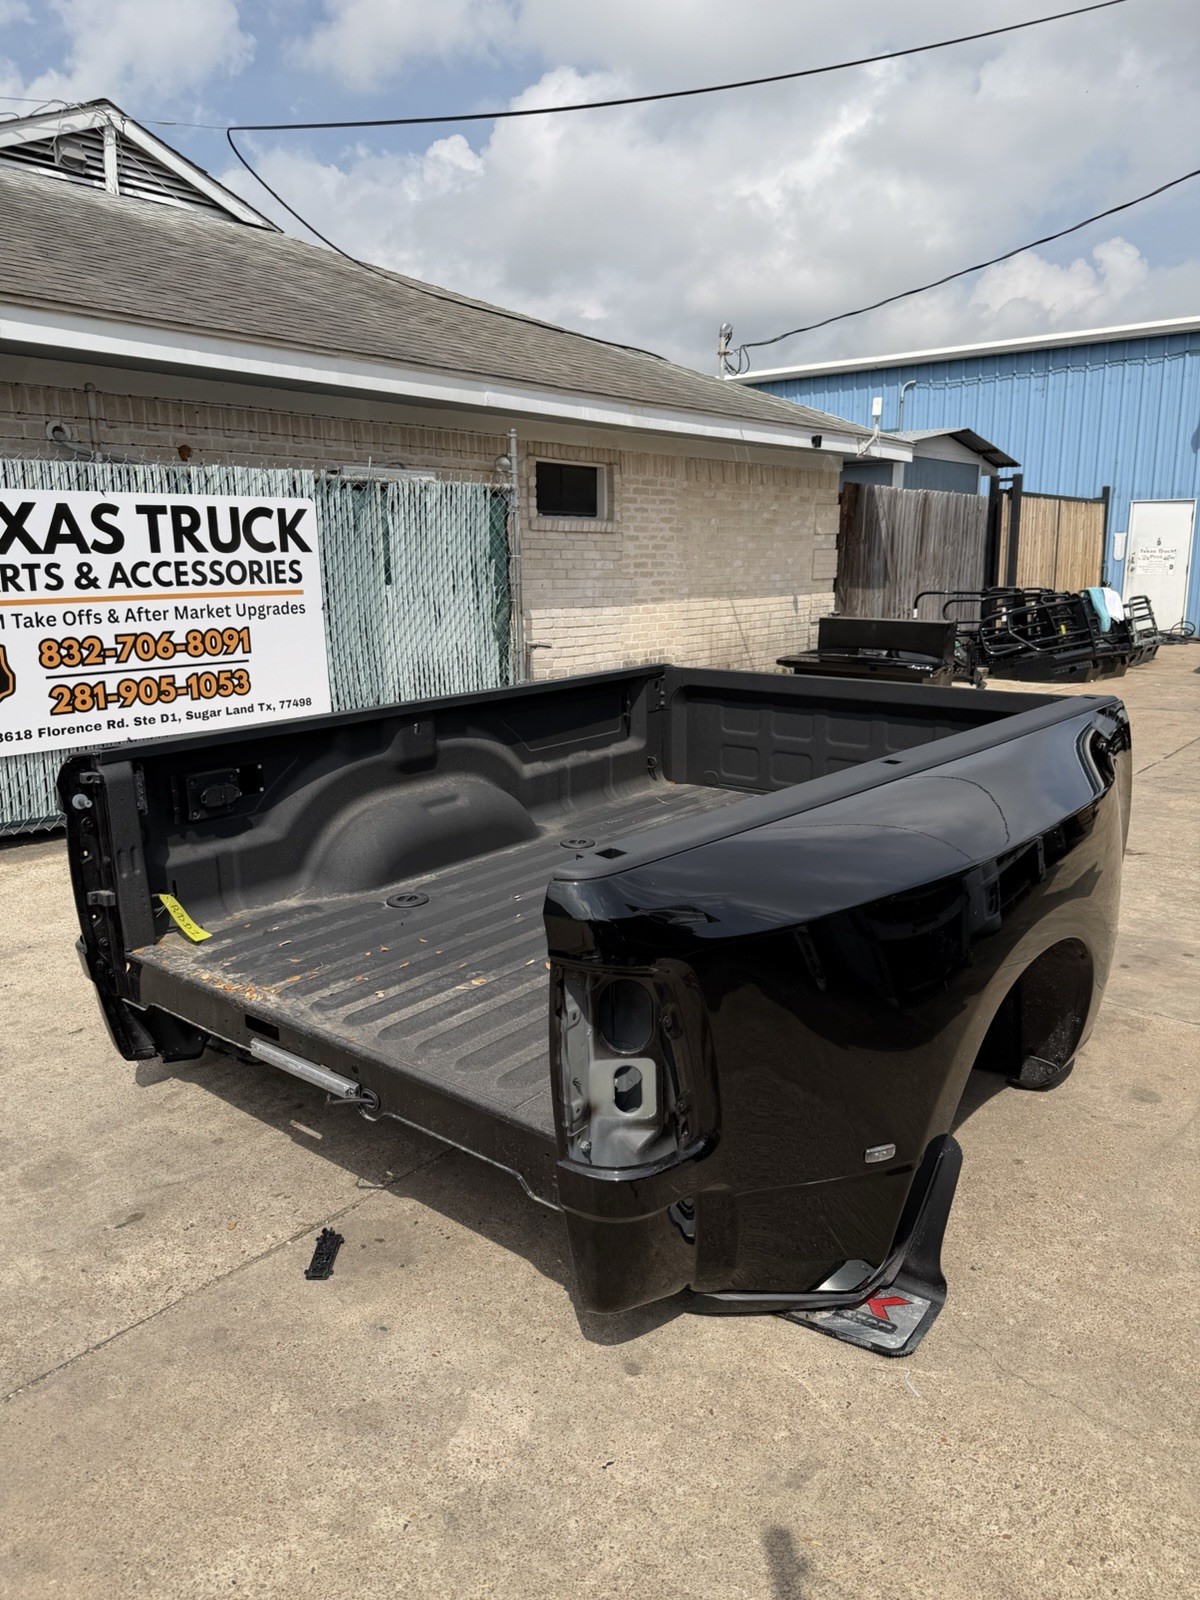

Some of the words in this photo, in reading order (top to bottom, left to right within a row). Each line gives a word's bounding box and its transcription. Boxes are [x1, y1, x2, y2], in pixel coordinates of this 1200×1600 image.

[0, 501, 125, 556] XAS
[134, 504, 313, 554] TRUCK
[0, 562, 65, 592] RTS
[74, 561, 101, 591] &
[107, 559, 303, 589] ACCESSORIES
[11, 611, 57, 629] Take
[62, 608, 103, 627] Offs
[107, 608, 120, 624] &
[124, 605, 170, 623] After
[173, 603, 232, 621] Market
[235, 600, 306, 621] Upgrades
[38, 626, 252, 671] 832-706-8091
[47, 668, 252, 717] 281-905-1053
[38, 722, 103, 739] Florence
[107, 718, 130, 731] Rd.
[133, 715, 156, 727] Ste
[160, 712, 182, 725] D1,
[185, 708, 222, 722] Sugar
[225, 703, 255, 717] Land
[258, 702, 277, 714] Tx,
[279, 697, 312, 710] 77498
